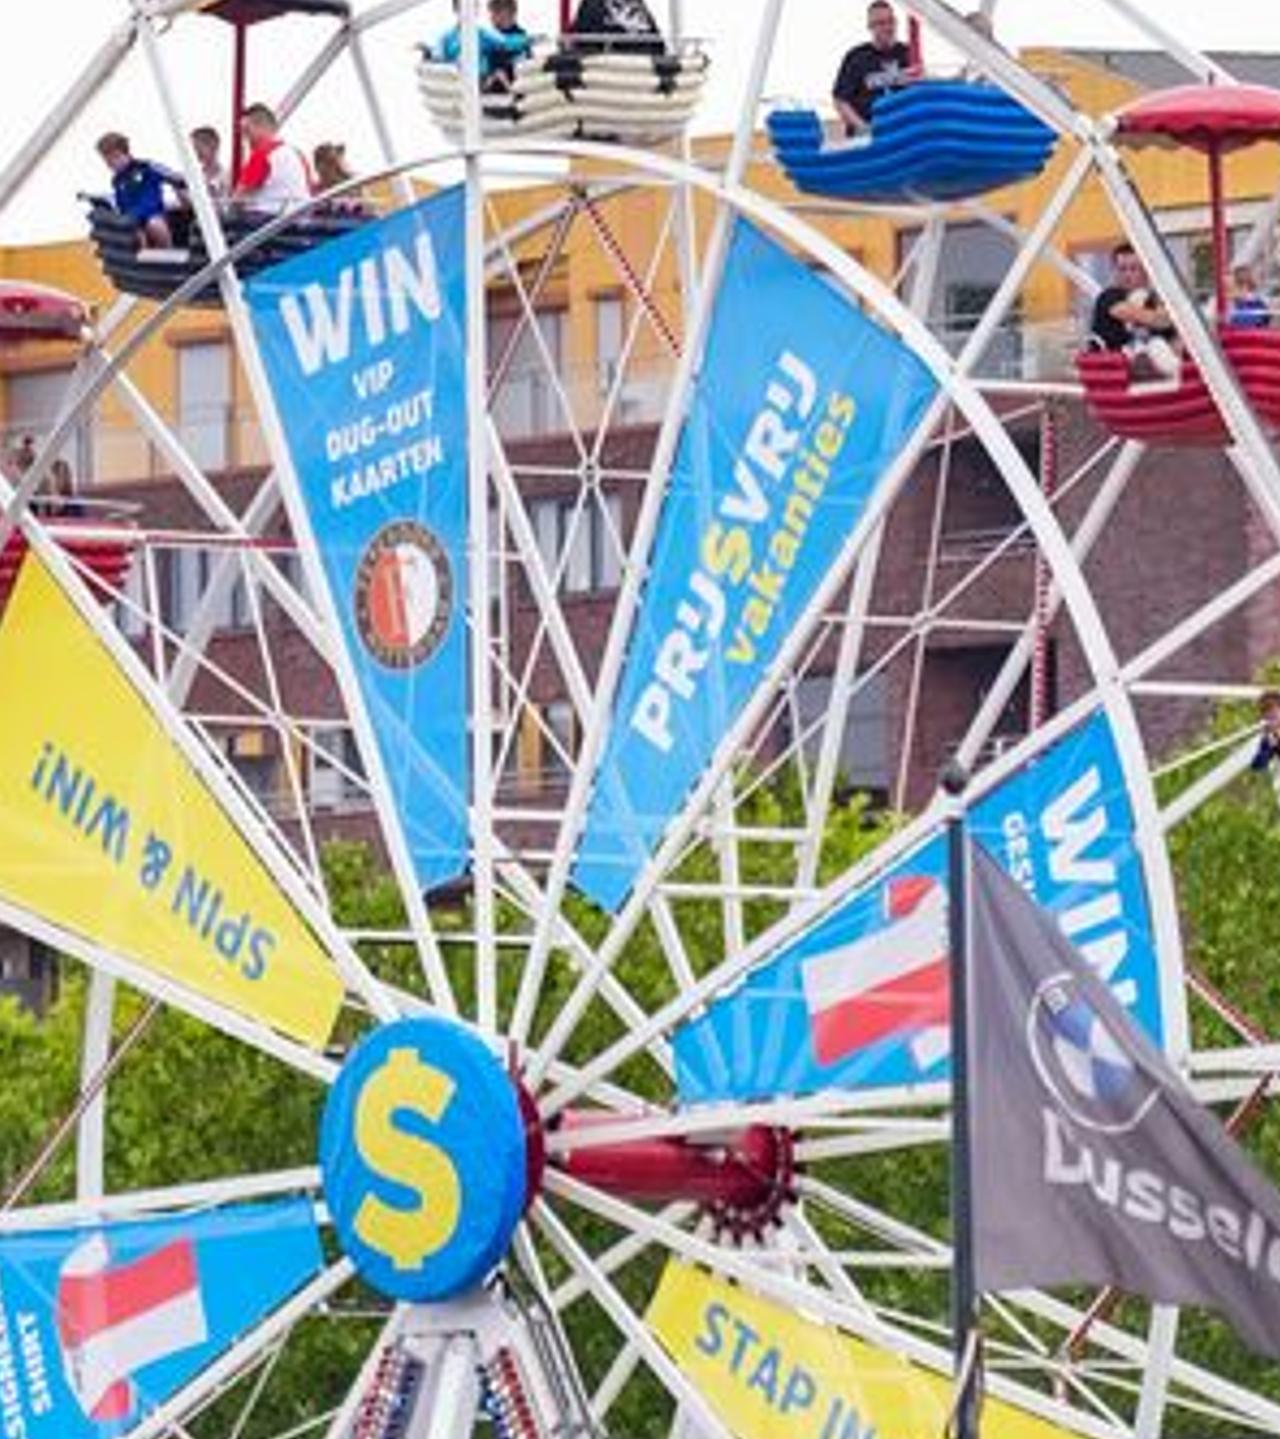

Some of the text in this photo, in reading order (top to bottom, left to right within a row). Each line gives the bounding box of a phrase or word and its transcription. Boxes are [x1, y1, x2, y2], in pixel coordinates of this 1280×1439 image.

[281, 231, 441, 376] WIN
[325, 389, 435, 463] DUG-OUT
[351, 360, 395, 399] VIP
[330, 435, 444, 510] KAARTEN
[725, 391, 857, 664] vakanties
[32, 741, 276, 980] SPIN & WIN!
[16, 1312, 53, 1416] SHIRT
[694, 1303, 817, 1414] STAP
